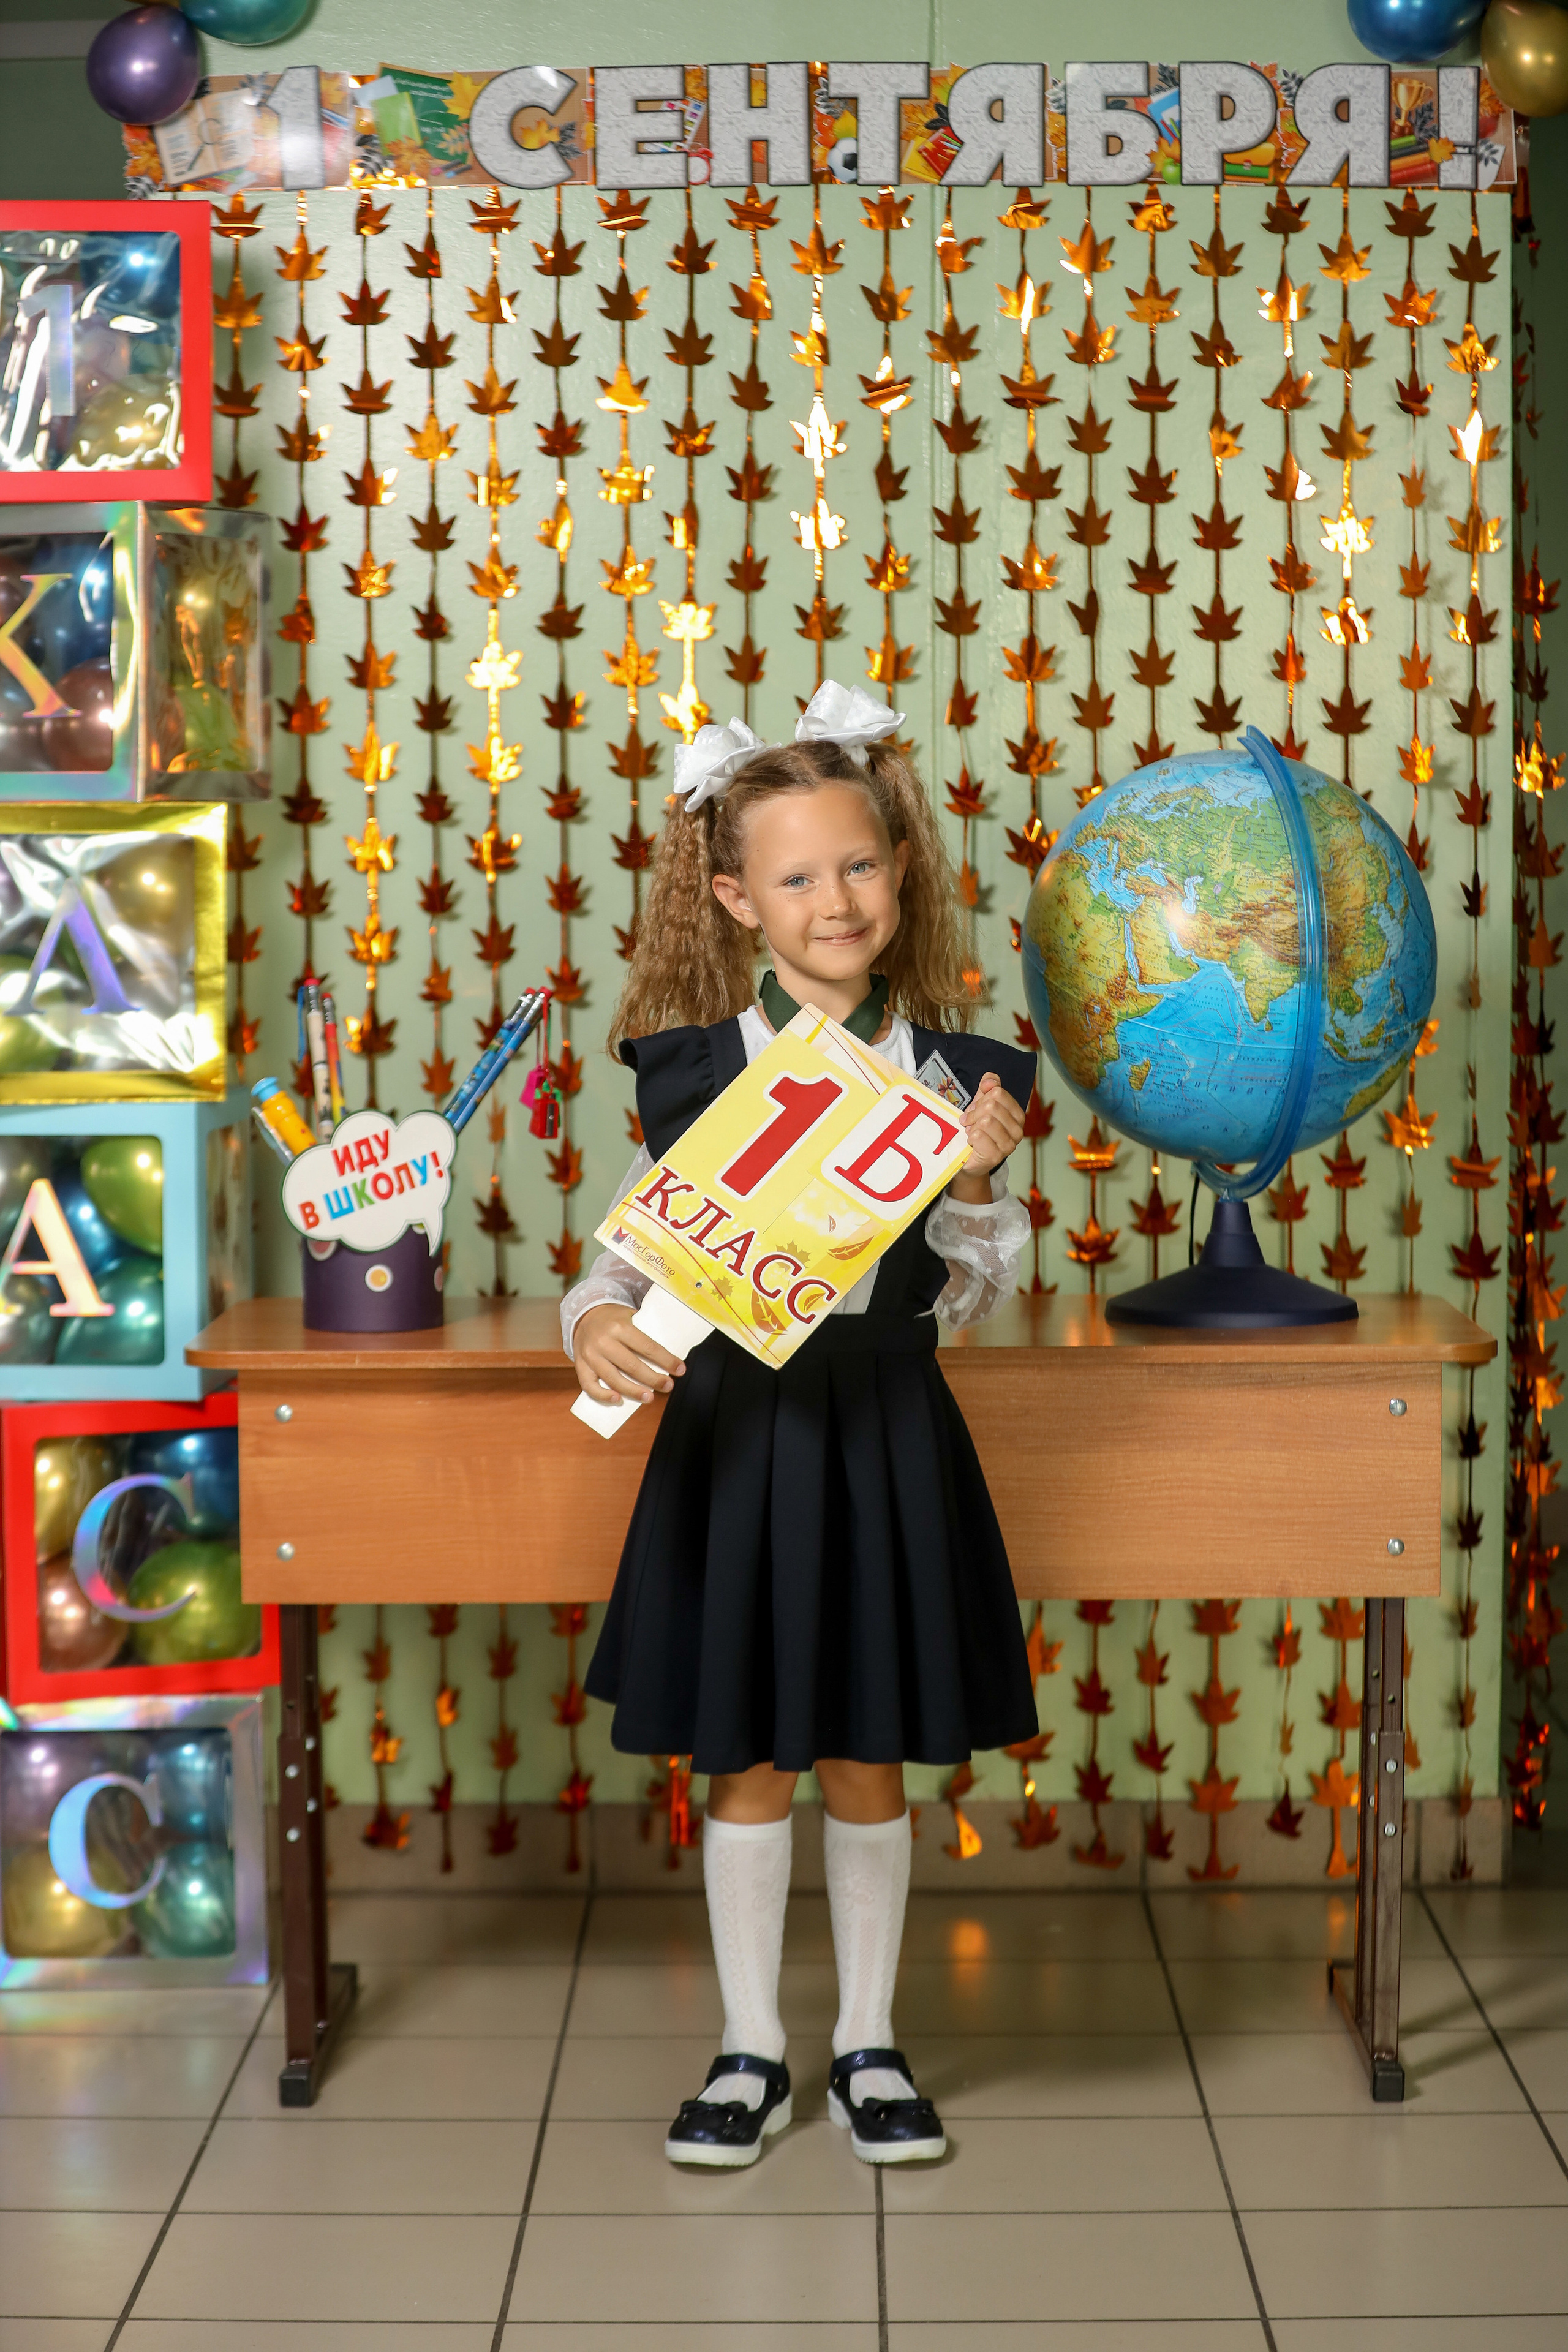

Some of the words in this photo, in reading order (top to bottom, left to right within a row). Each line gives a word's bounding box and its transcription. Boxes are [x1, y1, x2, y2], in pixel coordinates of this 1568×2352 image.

[264, 64, 325, 190] 1
[468, 60, 1480, 191] СЕНТЯБРЯ!
[332, 1130, 390, 1177] ИДУ
[721, 1075, 843, 1197] 1
[834, 1093, 960, 1202] Б
[298, 1201, 320, 1231] В
[323, 1151, 444, 1221] ШКОЛУ!
[625, 1235, 676, 1276] МосГорФото
[634, 1165, 837, 1324] КЛАСС
